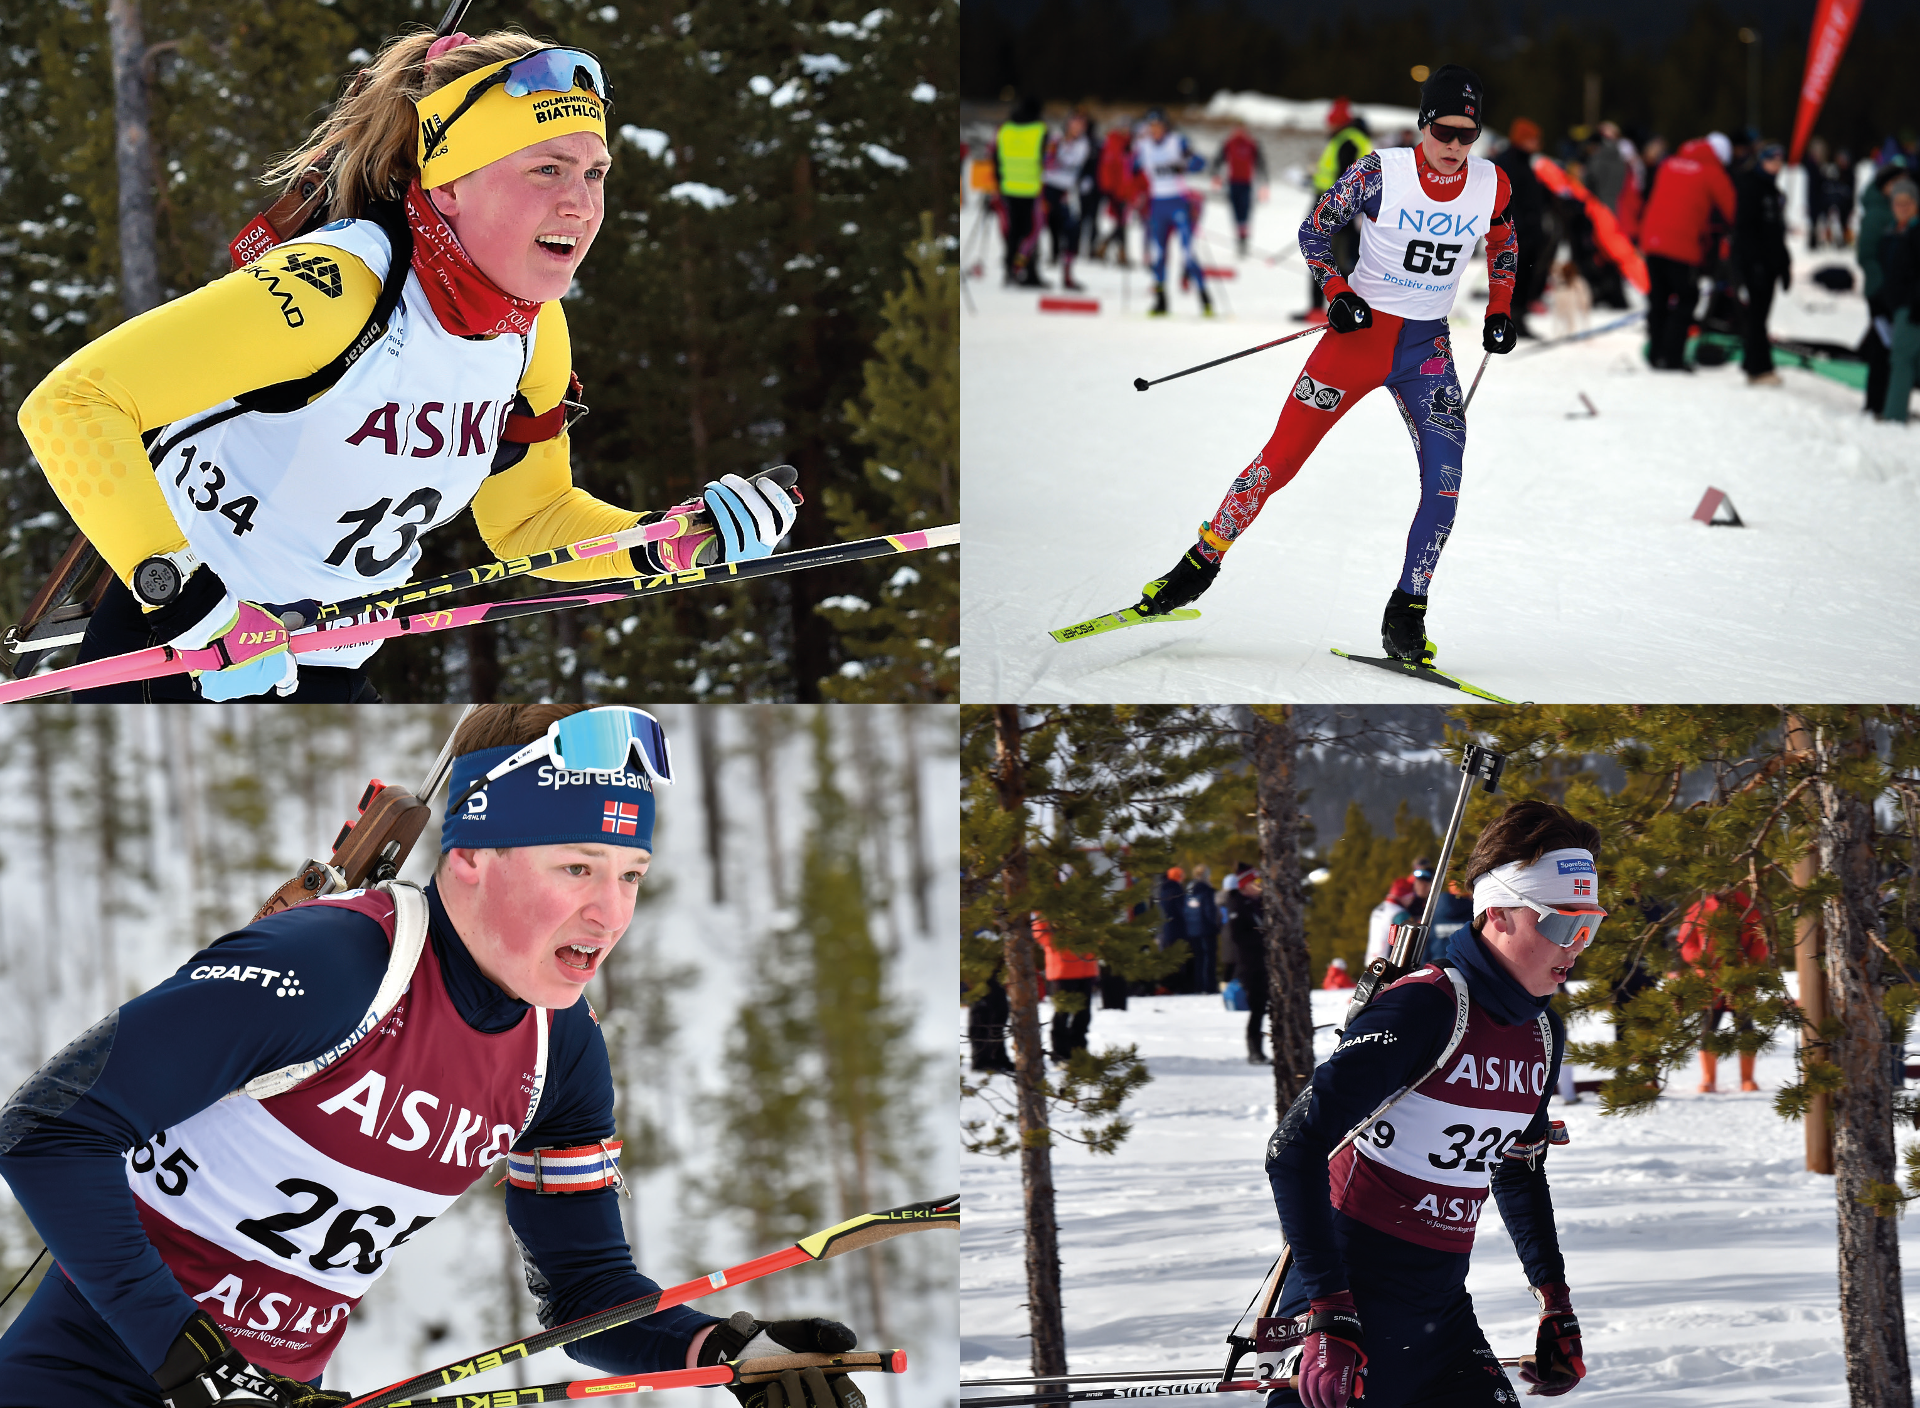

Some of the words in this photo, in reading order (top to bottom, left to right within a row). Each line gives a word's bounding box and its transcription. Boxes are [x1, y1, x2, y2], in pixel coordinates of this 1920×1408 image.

[535, 104, 602, 124] BIATHLON
[1398, 208, 1479, 237] NØK
[235, 225, 266, 253] TOLGA
[241, 246, 256, 262] OS
[1402, 239, 1463, 276] 65
[1383, 272, 1423, 290] positiv
[175, 444, 260, 537] 134
[323, 486, 443, 577] 13
[238, 629, 287, 645] LEKI
[537, 765, 652, 793] SpareBank
[1560, 860, 1591, 868] SpareBank
[190, 964, 281, 989] CRAFT
[1456, 992, 1467, 1034] LARSEN
[312, 1010, 380, 1072] LARSEN
[1334, 1032, 1383, 1053] CRAFT
[1540, 1016, 1552, 1057] LARSEN
[1444, 1053, 1546, 1097] ASKO
[890, 1210, 930, 1220] LEKI
[256, 1330, 286, 1348] Norge
[1265, 1322, 1307, 1339] ASKO
[441, 1342, 529, 1385] LEKI
[215, 1364, 277, 1396] LEKI
[1113, 1381, 1218, 1399] MADSHUS
